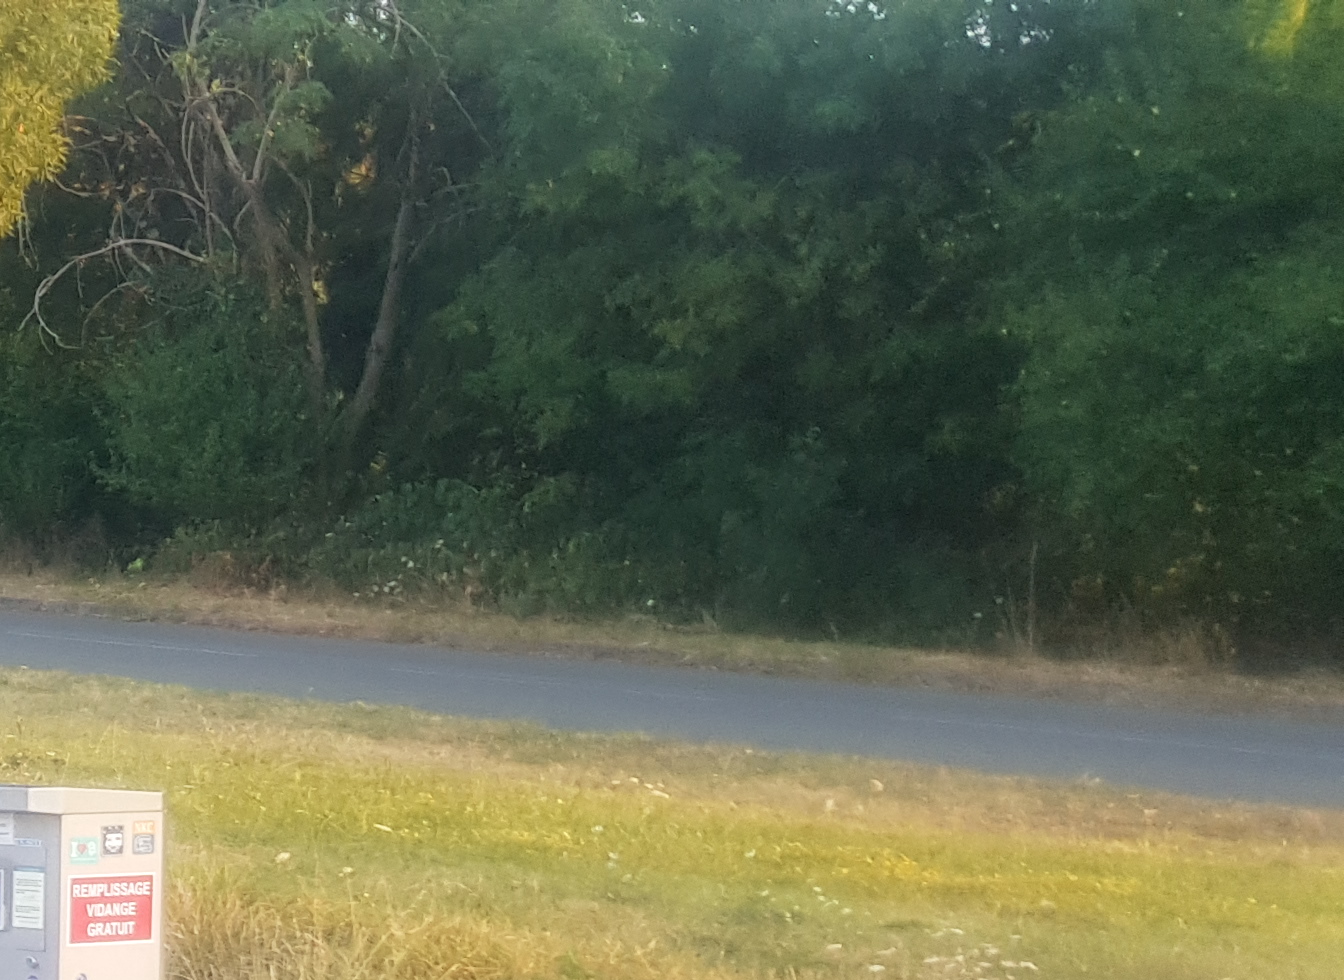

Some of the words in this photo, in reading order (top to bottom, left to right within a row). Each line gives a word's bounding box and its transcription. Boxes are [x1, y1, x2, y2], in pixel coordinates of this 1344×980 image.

[72, 881, 151, 898] REMPLISSAGE
[86, 901, 136, 917] VIDANGE
[87, 921, 135, 937] GRATUIT
